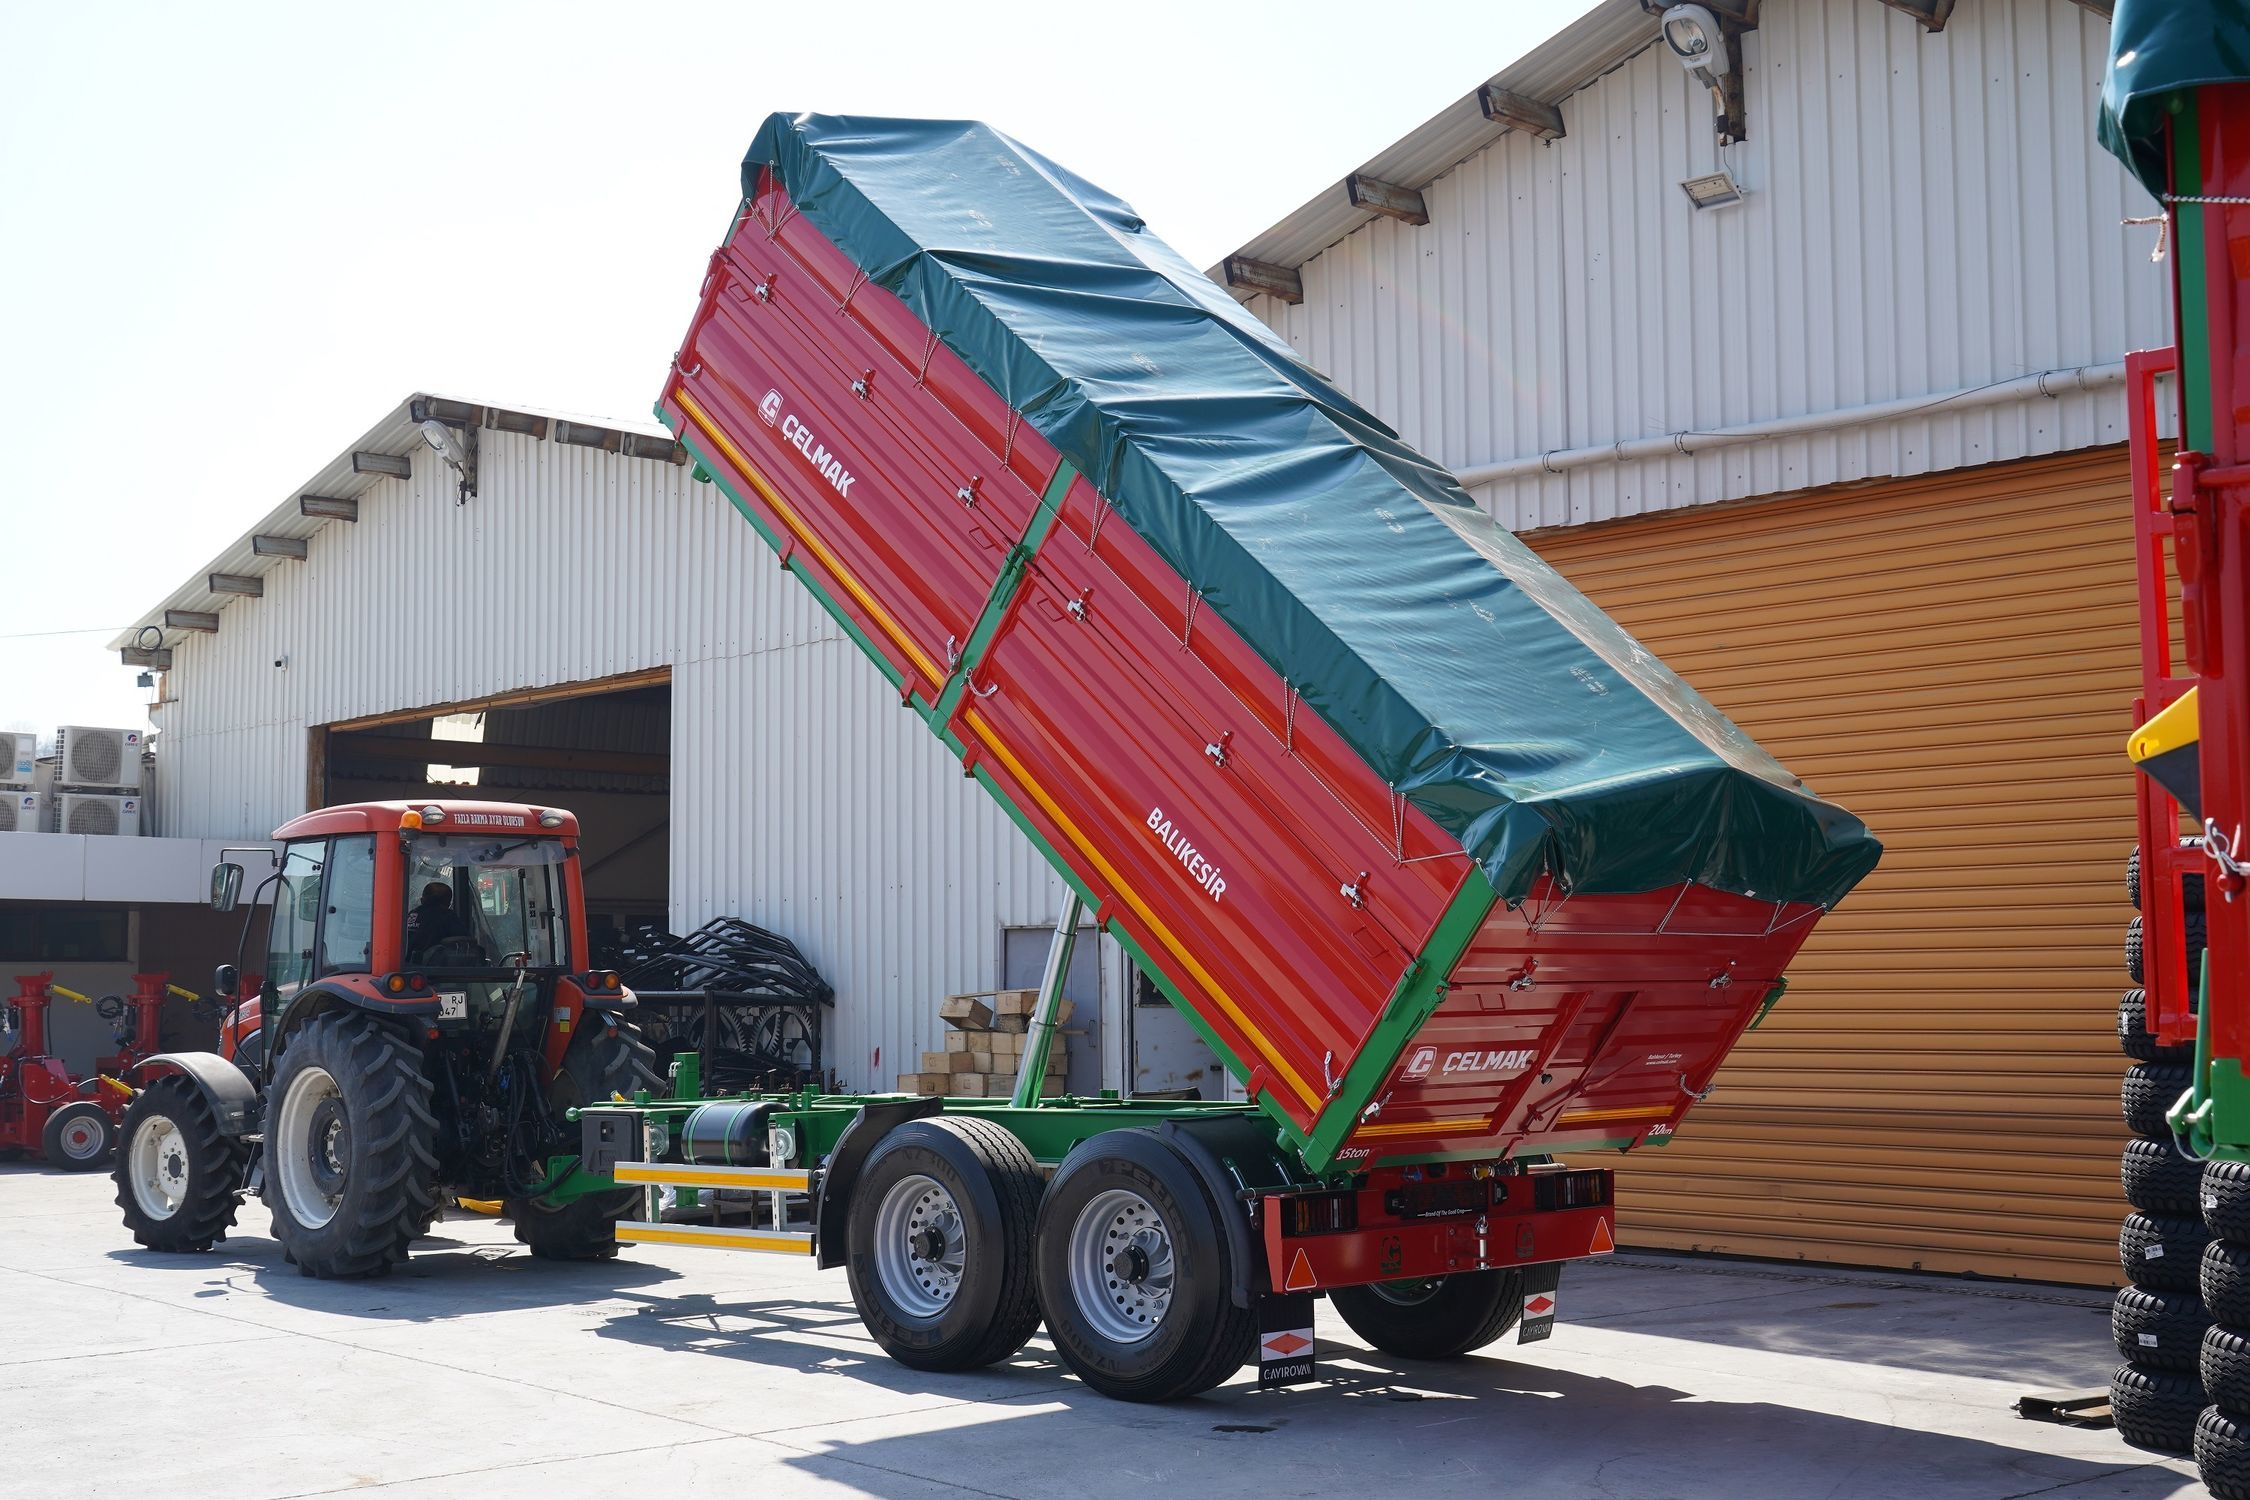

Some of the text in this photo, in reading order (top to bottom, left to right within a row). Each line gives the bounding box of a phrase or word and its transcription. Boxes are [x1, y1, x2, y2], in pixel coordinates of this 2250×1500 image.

[1146, 806, 1227, 903] BALIKESİR
[451, 995, 463, 1005] RJ
[1335, 1147, 1370, 1161] 15ton
